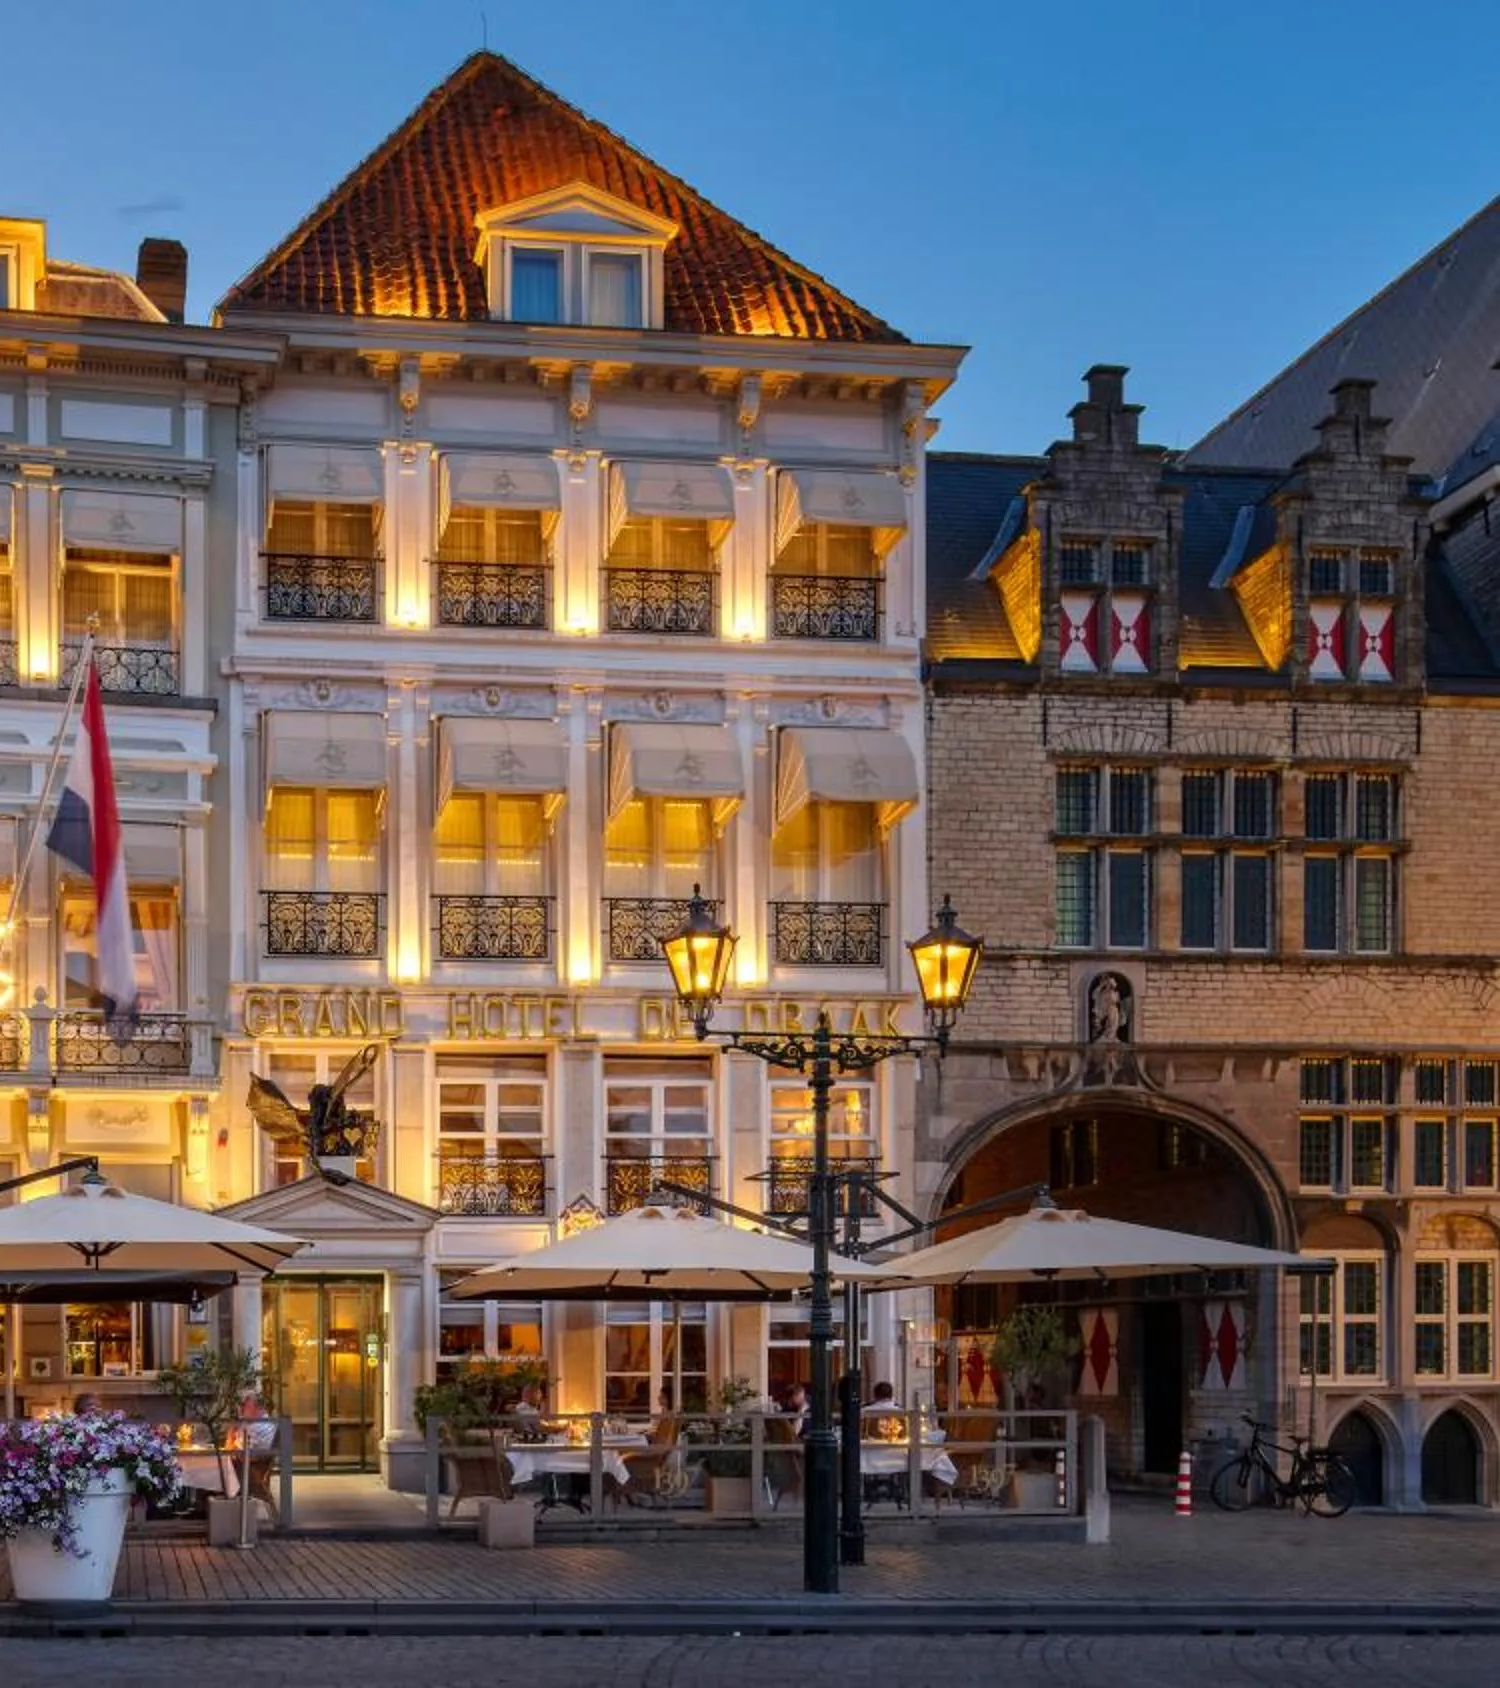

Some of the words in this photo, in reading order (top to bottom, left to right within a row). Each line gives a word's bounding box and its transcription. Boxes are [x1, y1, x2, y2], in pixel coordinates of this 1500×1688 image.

[243, 988, 405, 1038] GRAND
[448, 992, 597, 1041] HOTEL
[638, 996, 698, 1041] DE
